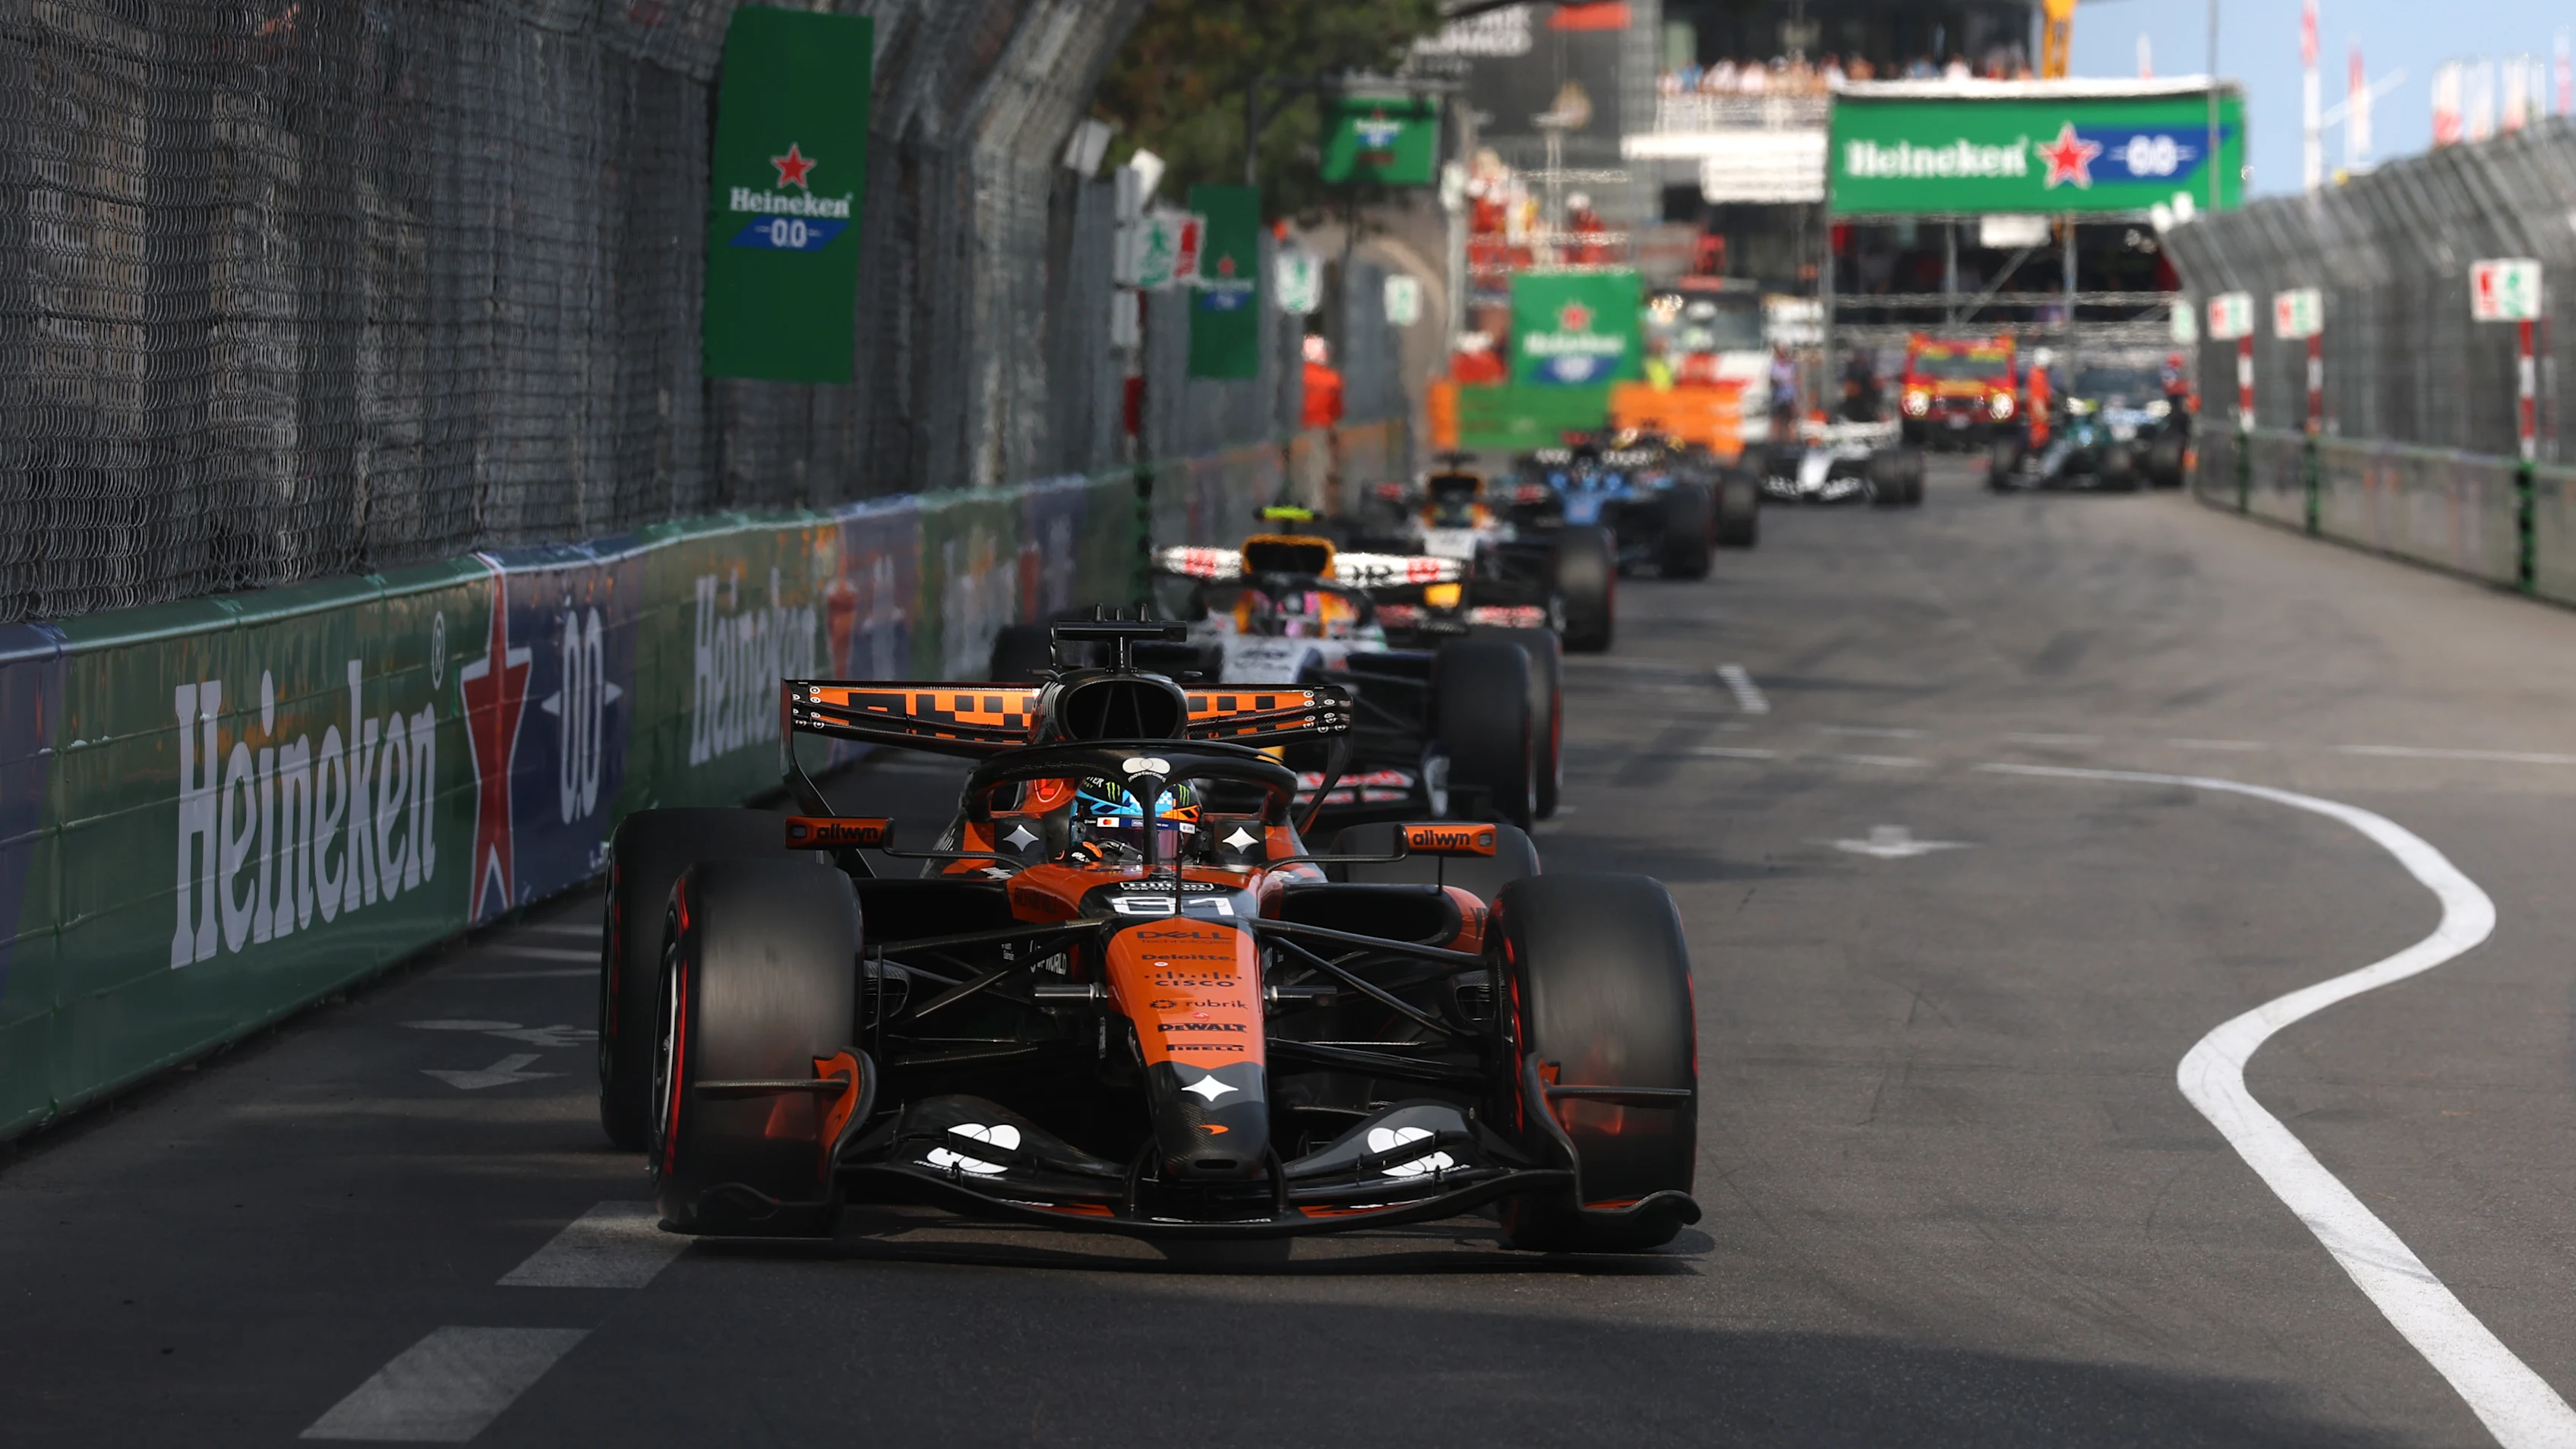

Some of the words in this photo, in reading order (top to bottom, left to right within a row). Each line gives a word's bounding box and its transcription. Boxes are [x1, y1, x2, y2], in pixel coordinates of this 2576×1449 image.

[1846, 137, 2028, 178] Heineken
[730, 187, 850, 218] Heineken
[561, 607, 603, 825] 0.0
[1128, 771, 1166, 783] mastercard
[171, 659, 436, 969] Heineken
[817, 823, 878, 841] allwyn
[1413, 830, 1470, 848] allwyn
[1137, 931, 1232, 940] DELL
[1185, 999, 1248, 1009] rubrik
[1166, 1043, 1244, 1052] PIRELLI
